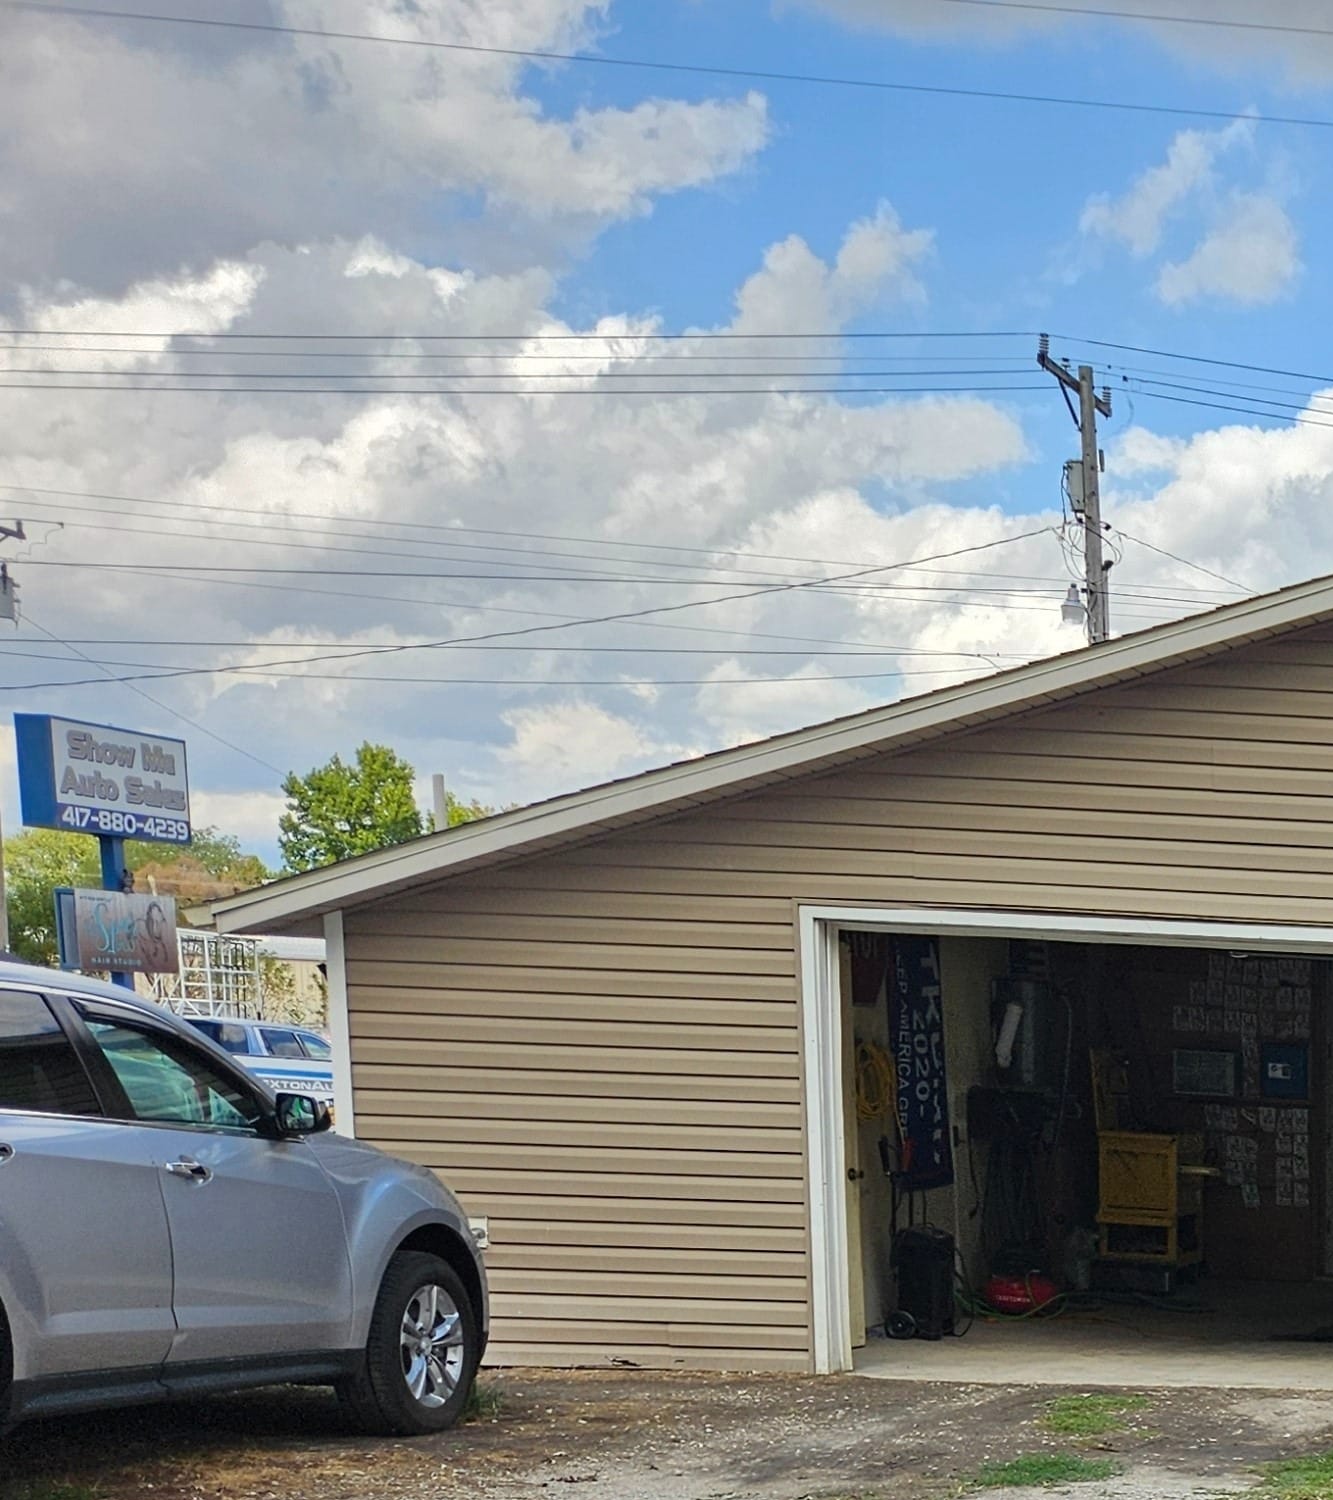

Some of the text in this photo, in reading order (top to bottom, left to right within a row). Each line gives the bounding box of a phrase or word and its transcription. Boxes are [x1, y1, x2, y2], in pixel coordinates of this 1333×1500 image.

[67, 730, 136, 770] Show
[60, 765, 186, 812] Auto Sales
[61, 806, 189, 841] 417-880-4239
